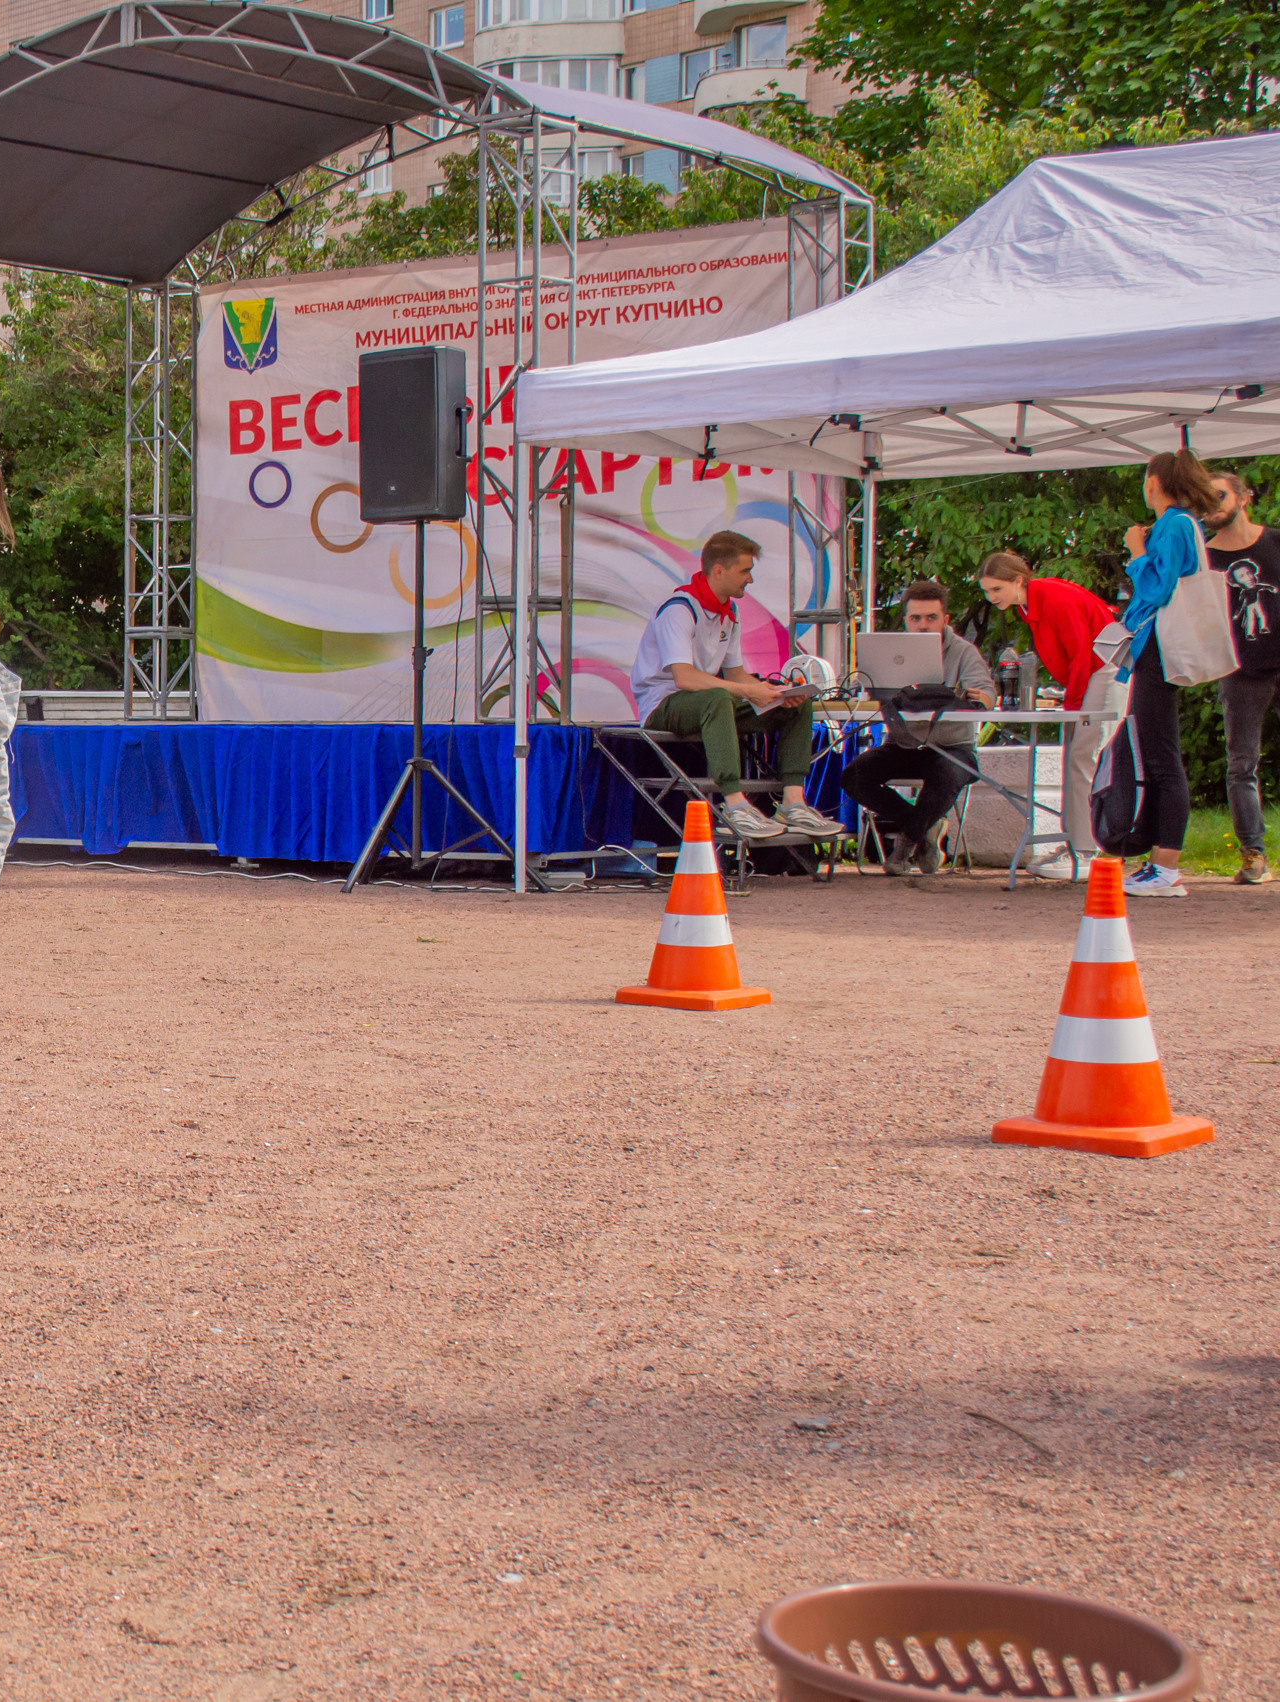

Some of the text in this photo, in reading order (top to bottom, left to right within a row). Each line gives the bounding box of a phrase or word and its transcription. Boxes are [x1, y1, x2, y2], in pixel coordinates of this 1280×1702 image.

[294, 300, 345, 316] МЕСТНАЯ
[345, 289, 447, 312] АДМИНИСТРАЦИЯ
[576, 262, 697, 287] МУНИЦИПАЛЬНОГО
[392, 309, 401, 319] Г.
[402, 299, 493, 320] ФЕДЕРАЛЬНОО
[494, 289, 556, 311] ЗНАЕИЯ
[544, 307, 611, 331] ОКРУГ
[615, 295, 723, 325] КУПЧИНО
